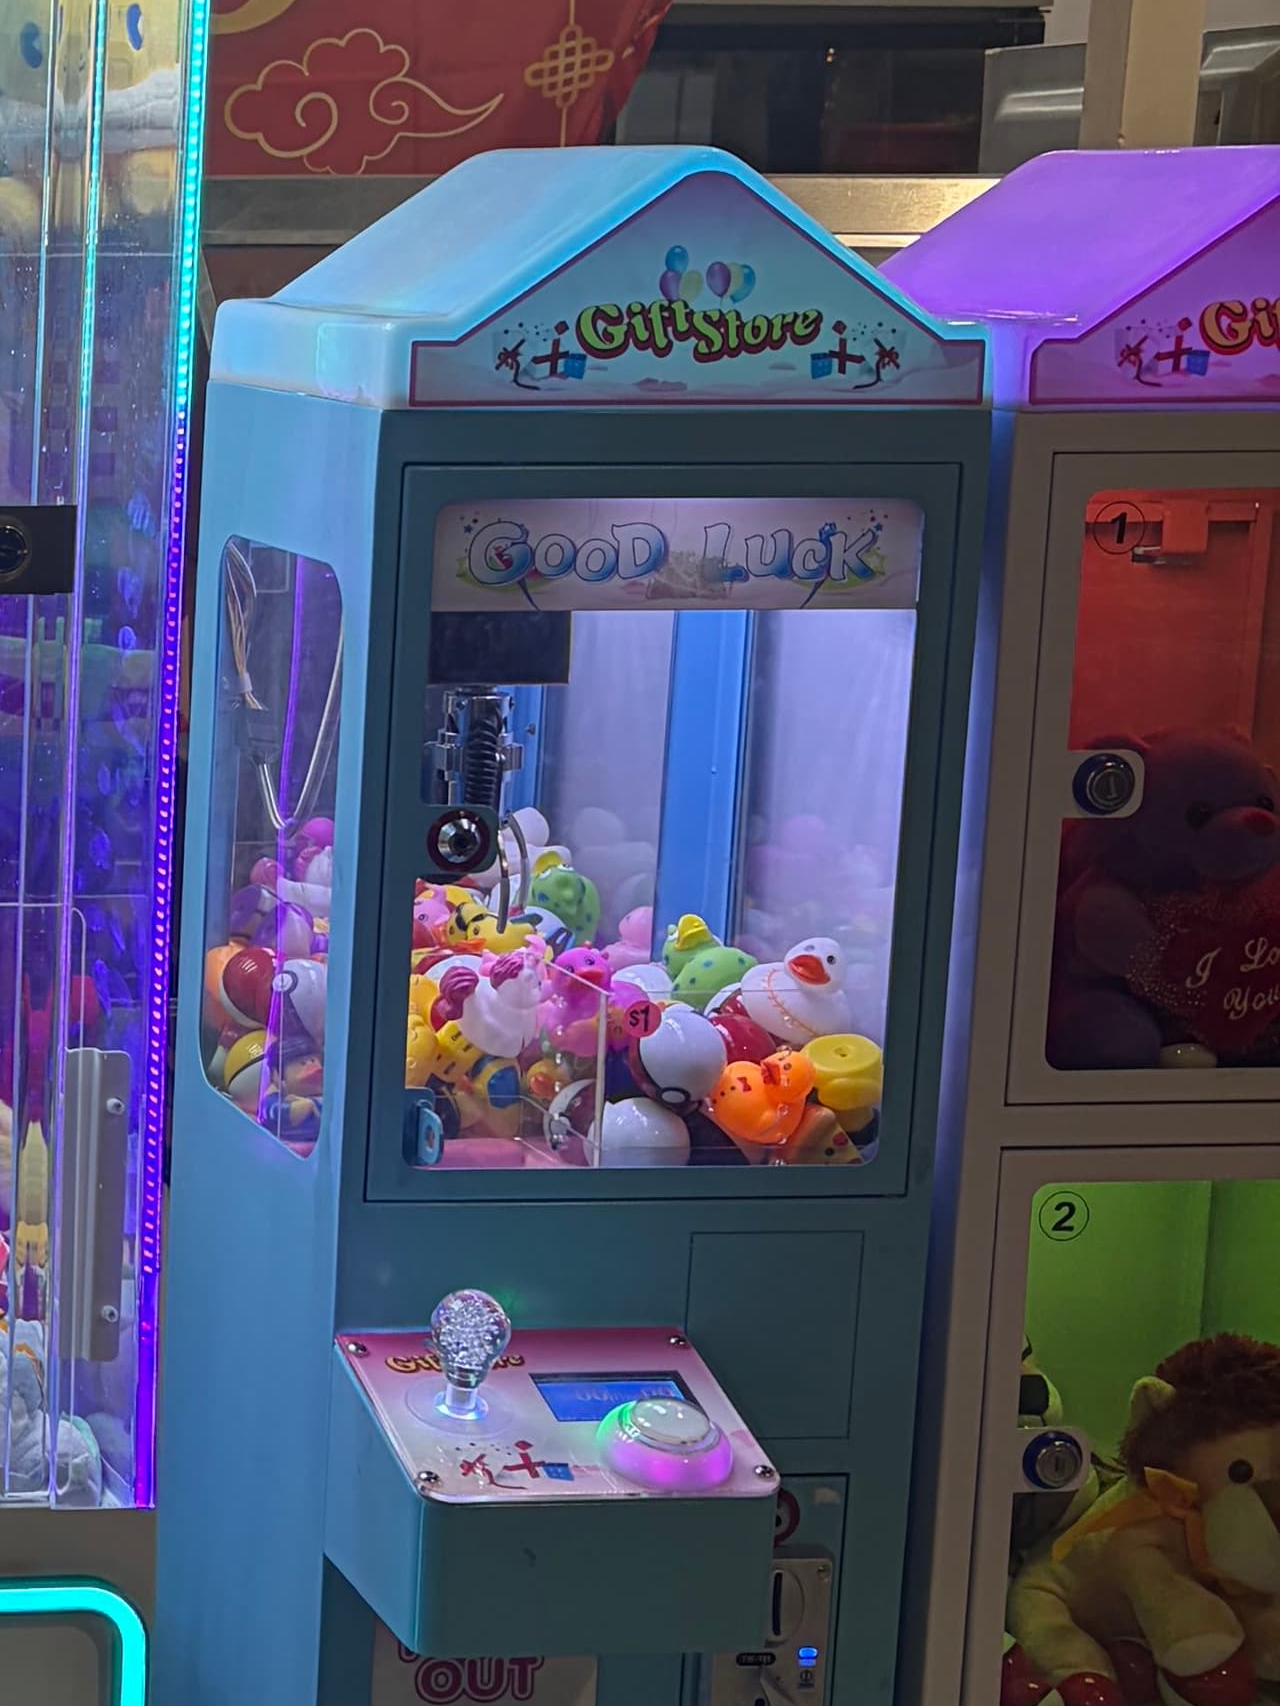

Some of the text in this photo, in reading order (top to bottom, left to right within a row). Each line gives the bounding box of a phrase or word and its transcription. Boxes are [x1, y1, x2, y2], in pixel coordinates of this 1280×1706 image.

[576, 299, 823, 364] Gift Store
[1186, 947, 1222, 988] I
[628, 1005, 651, 1032] $1
[1051, 1201, 1076, 1231] 2
[416, 1656, 544, 1705] OUT
